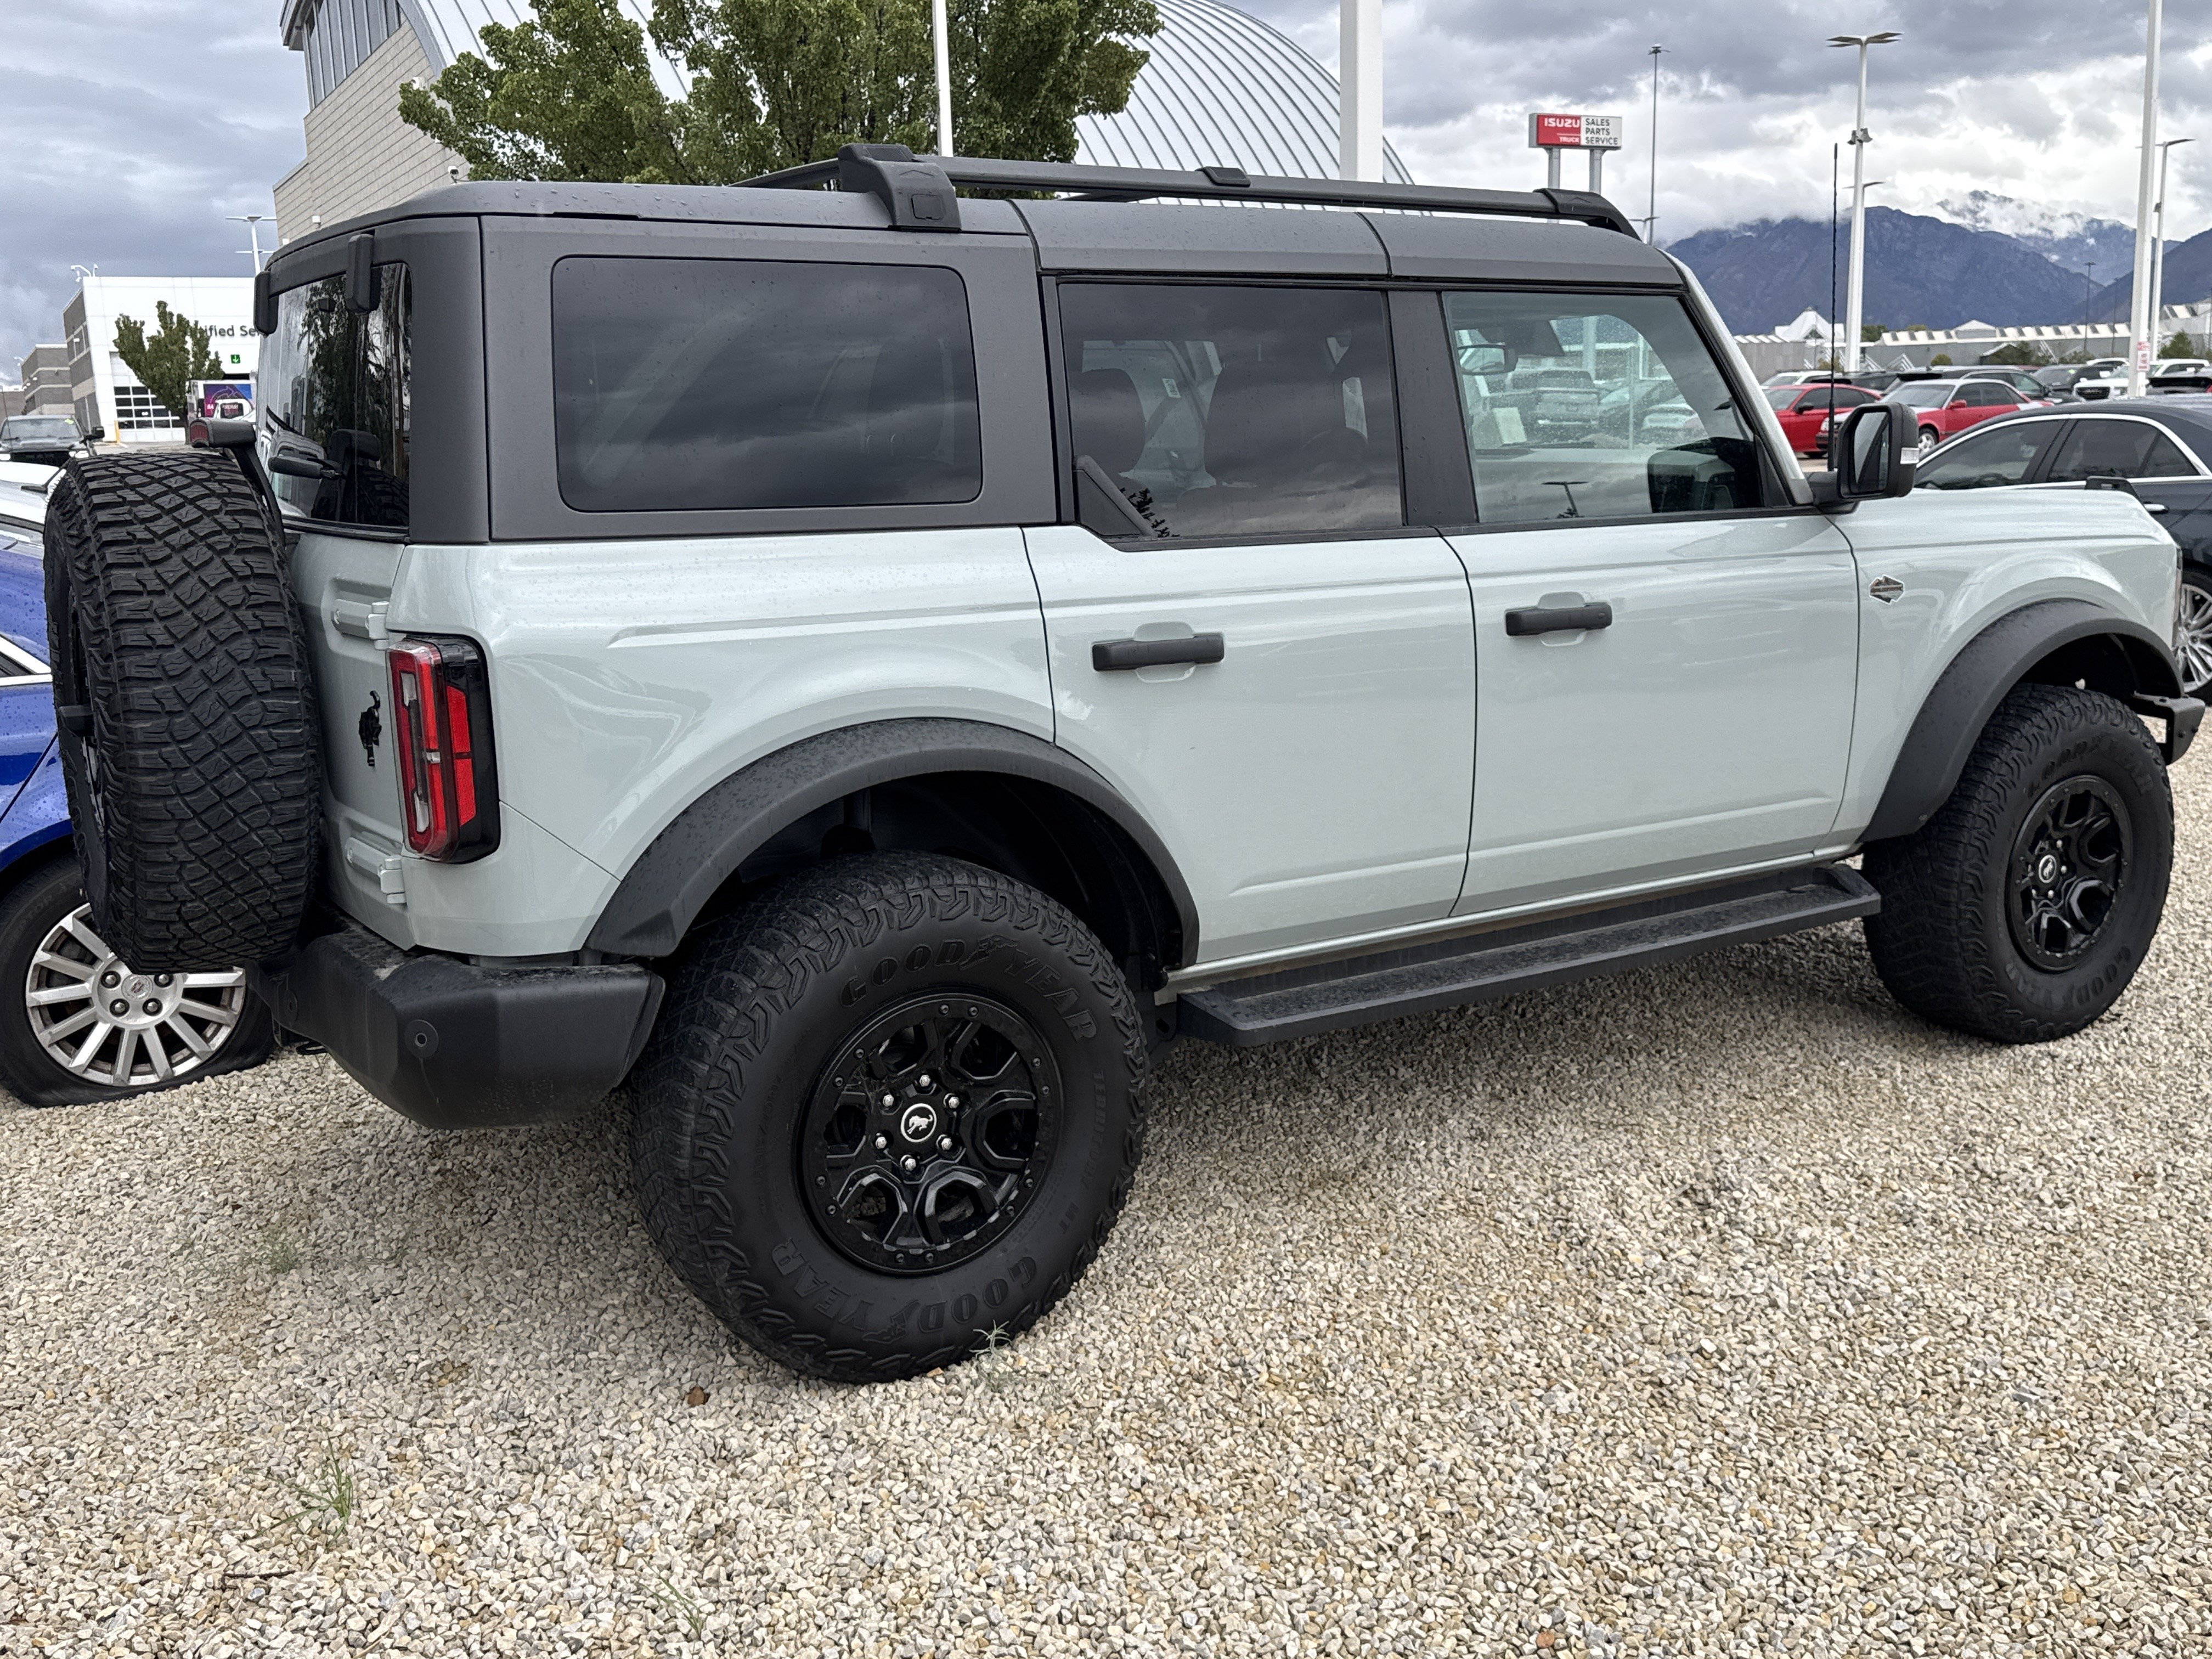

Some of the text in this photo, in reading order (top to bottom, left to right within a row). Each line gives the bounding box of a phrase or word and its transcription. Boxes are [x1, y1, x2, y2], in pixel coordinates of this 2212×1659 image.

[1544, 118, 1580, 127] ISUZU
[1585, 118, 1610, 126] SALES
[1585, 137, 1618, 145] SERVICE
[205, 325, 235, 336] ified
